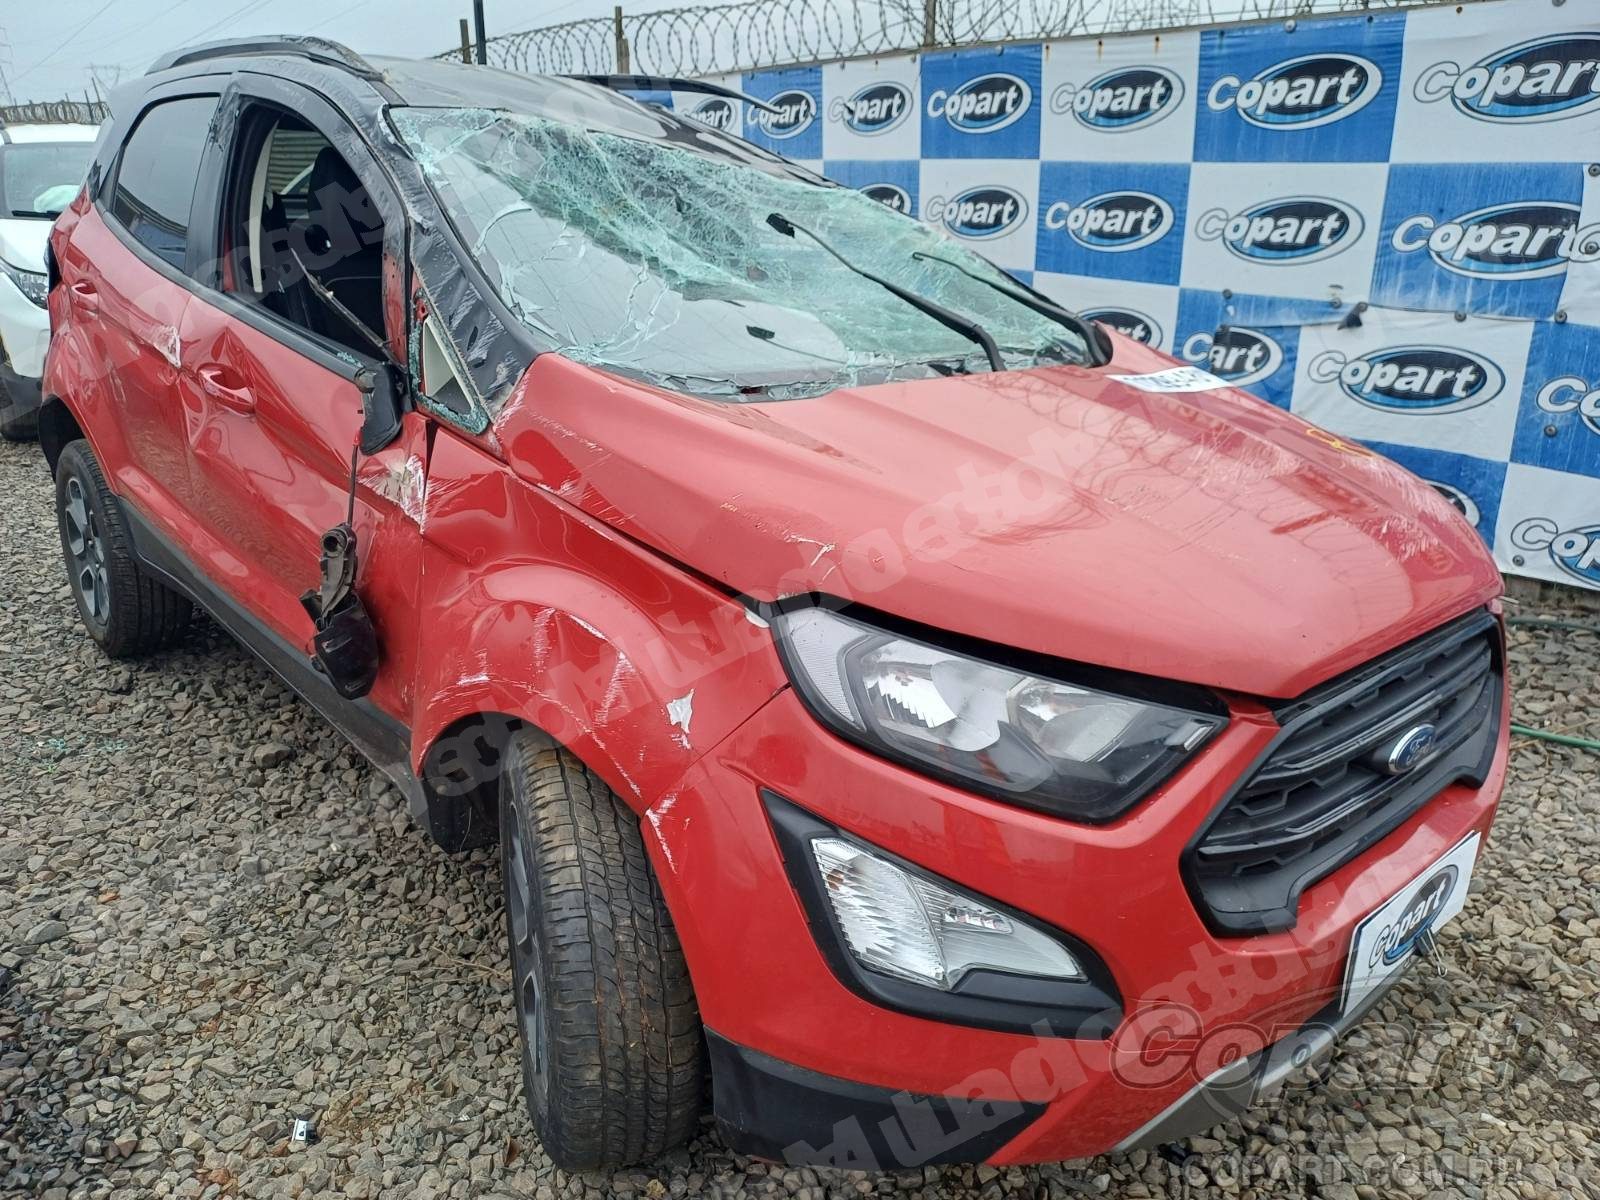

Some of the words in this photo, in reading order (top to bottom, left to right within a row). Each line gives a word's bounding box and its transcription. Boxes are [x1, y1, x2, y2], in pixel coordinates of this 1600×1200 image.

[926, 83, 1019, 121] Copart
[1050, 76, 1167, 120] Copart
[1207, 65, 1361, 116] Copart
[925, 193, 1015, 229] Copart
[1045, 201, 1158, 240] Copart
[1195, 208, 1342, 249] Copart
[1392, 214, 1578, 261] Copart
[1308, 350, 1477, 398] Copart
[1369, 875, 1447, 968] Copart
